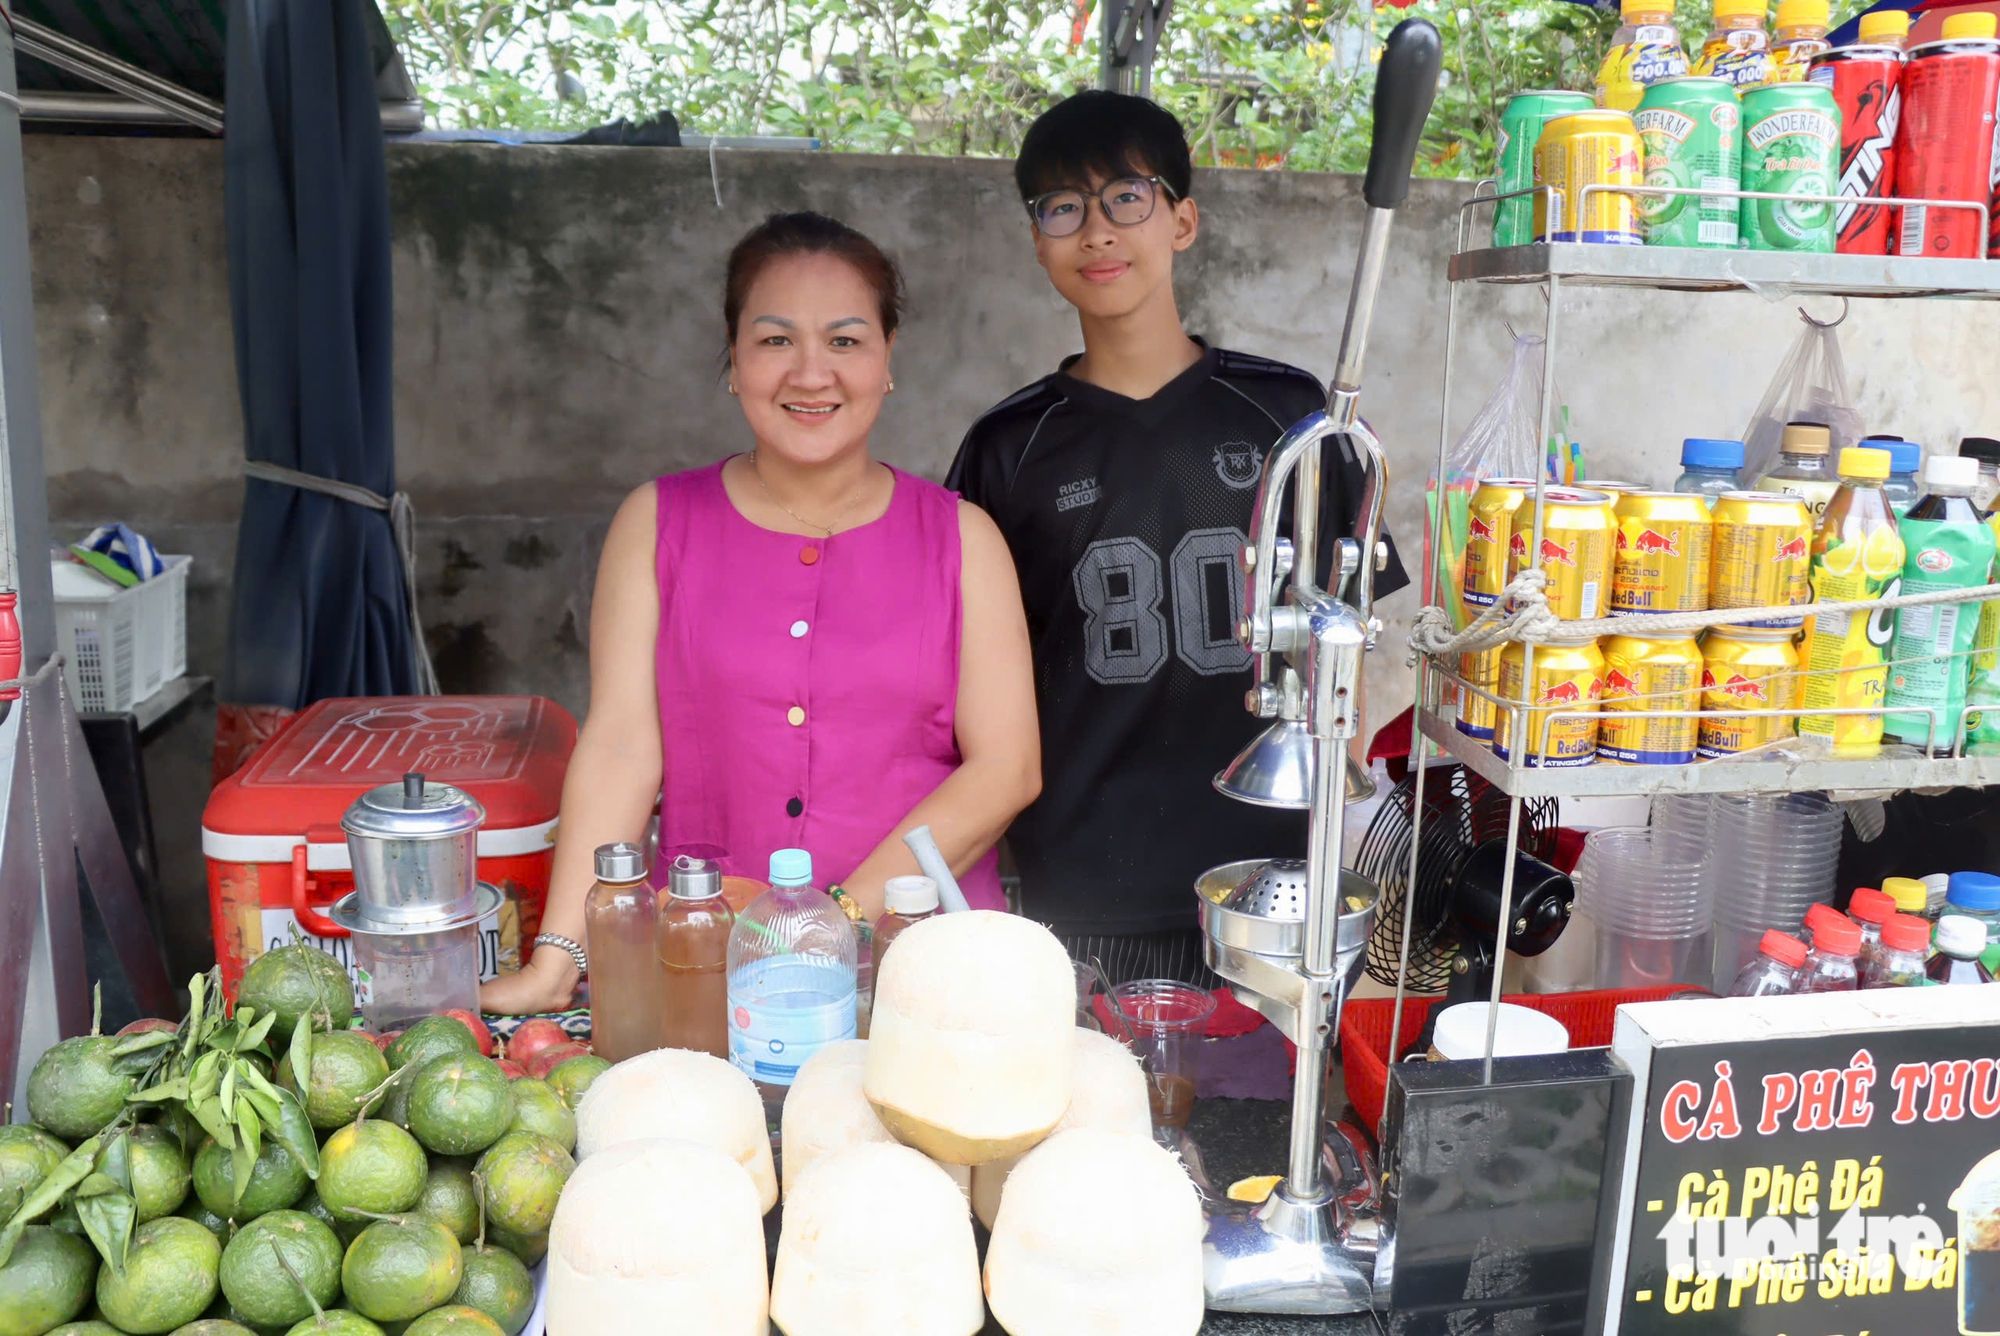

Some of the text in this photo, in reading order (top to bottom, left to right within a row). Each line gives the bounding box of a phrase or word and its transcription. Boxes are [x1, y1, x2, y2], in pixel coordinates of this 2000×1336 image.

[1634, 112, 1688, 136] DERFARM
[1071, 526, 1256, 685] 80
[1698, 729, 1739, 748] edBull
[1661, 1060, 1742, 1144] CÀ
[1757, 1048, 1877, 1135] PHÊ
[1676, 1168, 1731, 1225] Cà
[1740, 1160, 1820, 1219] Phê
[1829, 1155, 1884, 1212] Đá
